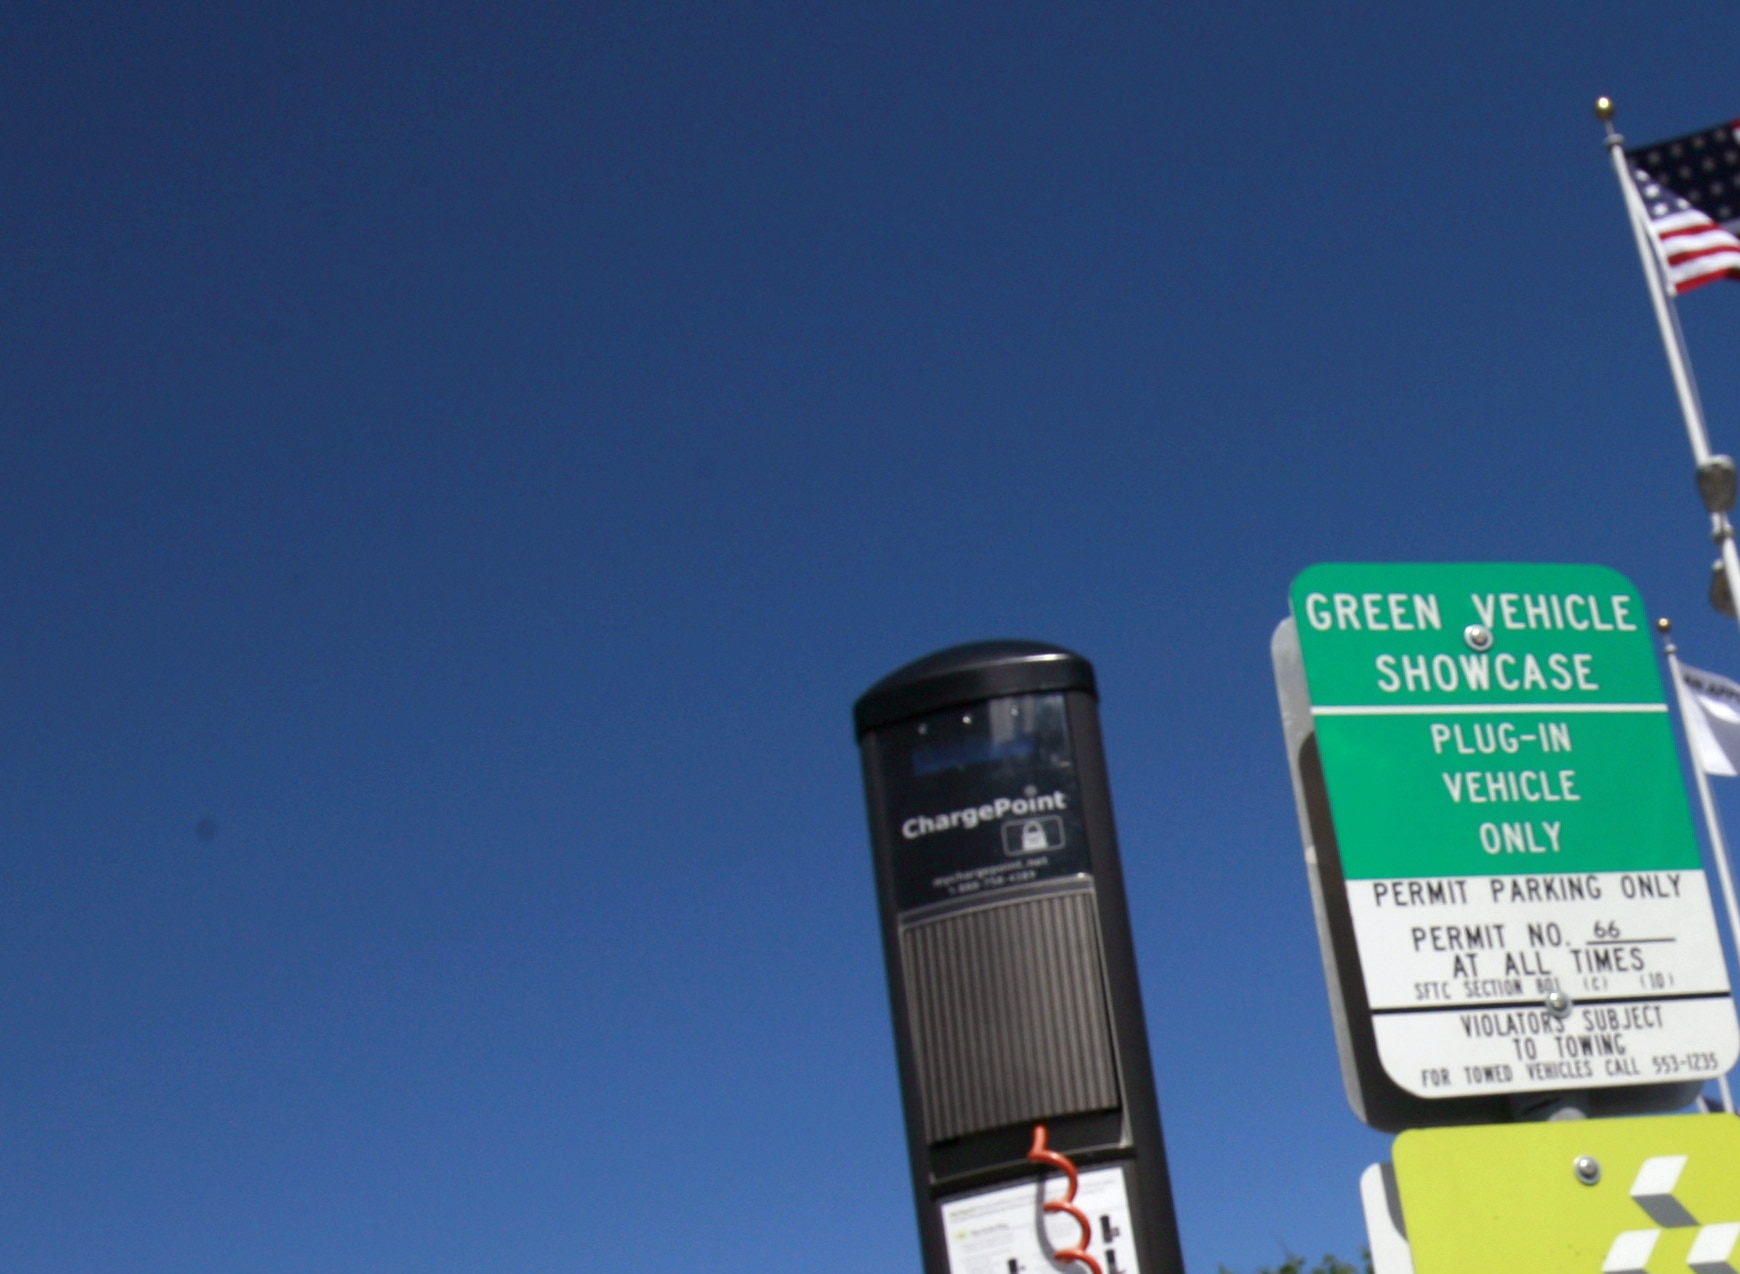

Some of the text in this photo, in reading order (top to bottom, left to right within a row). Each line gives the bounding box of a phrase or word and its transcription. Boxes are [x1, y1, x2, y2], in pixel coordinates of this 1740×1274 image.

[1306, 592, 1637, 632] GREEN VEHICLE
[1375, 653, 1599, 693] SHOWCASE
[1430, 722, 1572, 755] PLUG-IN
[1443, 770, 1581, 802] VEHICLE
[902, 785, 1067, 840] ChargePoint
[1479, 821, 1561, 854] ONLY
[1373, 873, 1681, 907] PERMIT PARKING ONLY
[1411, 920, 1620, 951] PERMIT NO. 66
[1453, 947, 1645, 979] AT ALL TIMES
[1463, 978, 1523, 998] SECTION
[1460, 1005, 1664, 1038] VIOLATORS SUBJECT
[1512, 1033, 1627, 1061] TO TOWING
[1421, 1067, 1451, 1088] FOR
[1463, 1064, 1514, 1085] TOWED
[1526, 1060, 1593, 1081] VEHICLES
[1604, 1057, 1641, 1077] CALL
